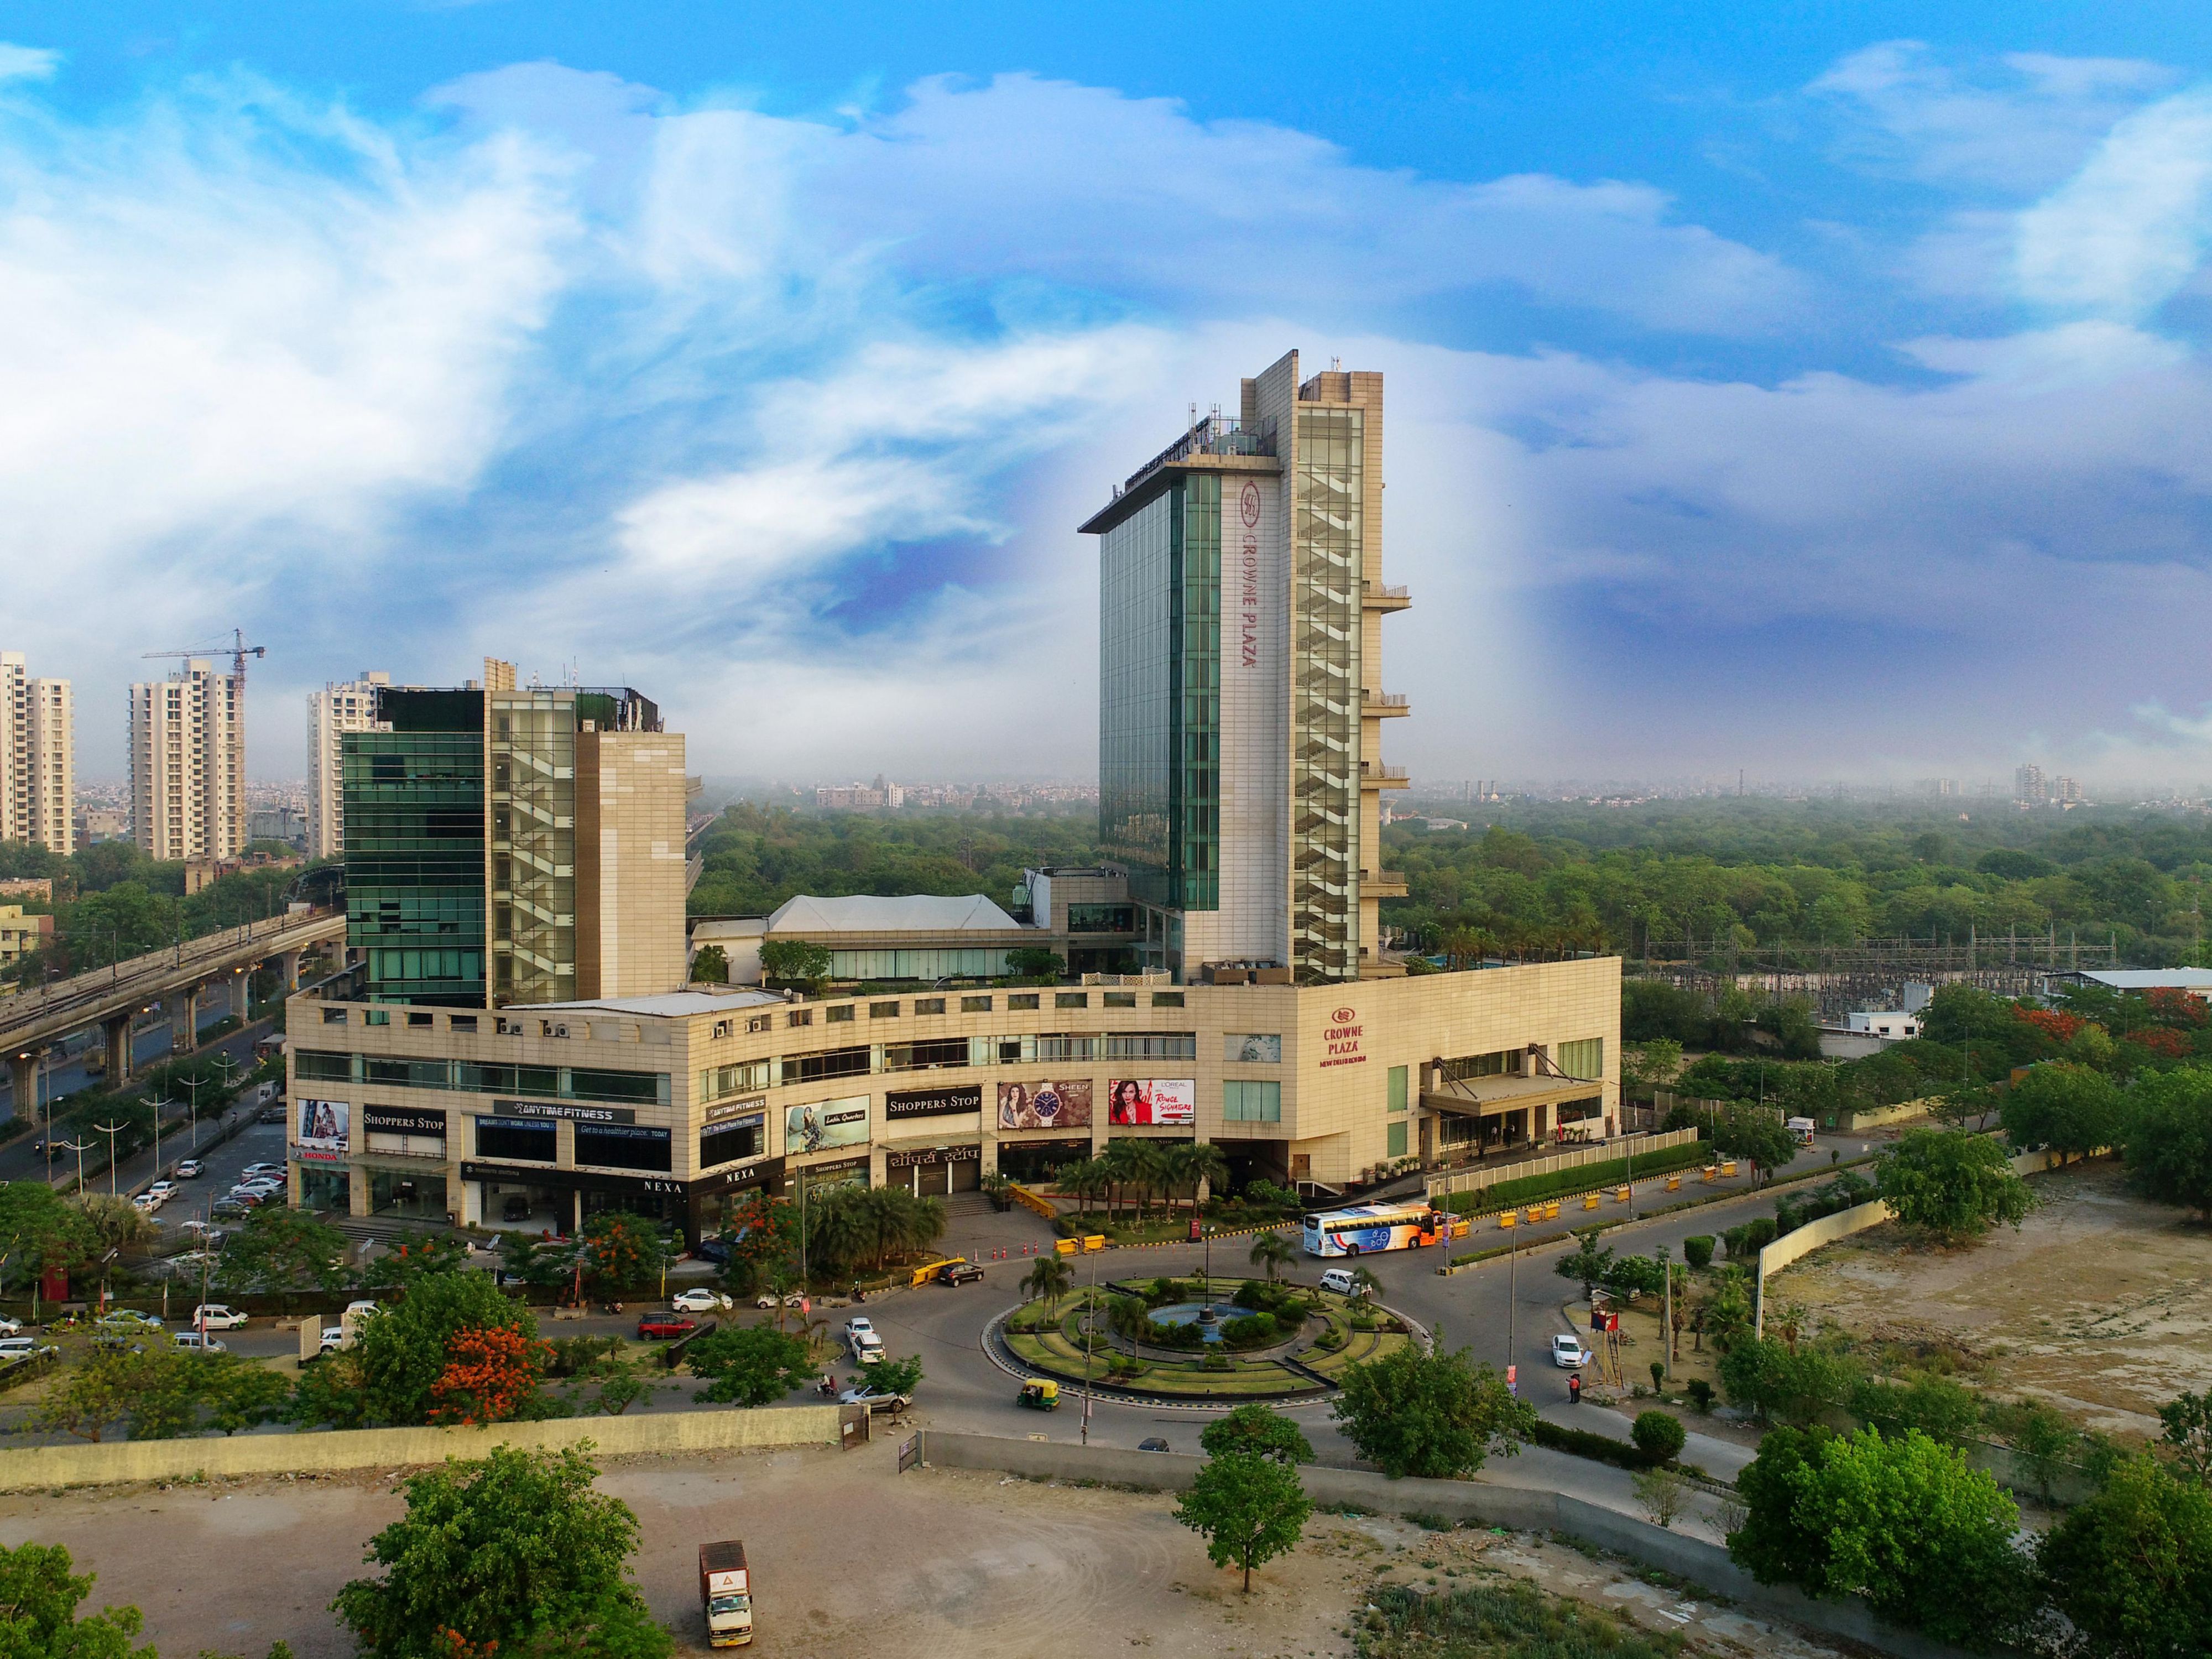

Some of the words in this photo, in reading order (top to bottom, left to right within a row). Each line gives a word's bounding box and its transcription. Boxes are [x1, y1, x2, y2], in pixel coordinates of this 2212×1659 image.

[1243, 533, 1257, 606] CROWNE
[1242, 613, 1257, 667] PLAZA
[1324, 1025, 1363, 1041] CROWNE
[1329, 1041, 1358, 1055] PLAZA
[890, 1099, 947, 1112] SHOPPERS
[950, 1095, 979, 1107] STOP
[1155, 1093, 1178, 1105] ROUGE
[364, 1113, 415, 1127] SHOPPERS
[418, 1118, 444, 1130] STOP
[826, 1115, 841, 1124] Latin
[842, 1112, 864, 1122] Quarters
[581, 1125, 592, 1133] Get
[603, 1126, 629, 1135] healthier
[304, 1152, 337, 1161] HONDA
[727, 1168, 754, 1183] NEXA
[815, 1165, 842, 1173] SHOPPERS
[644, 1181, 682, 1193] NEXA
